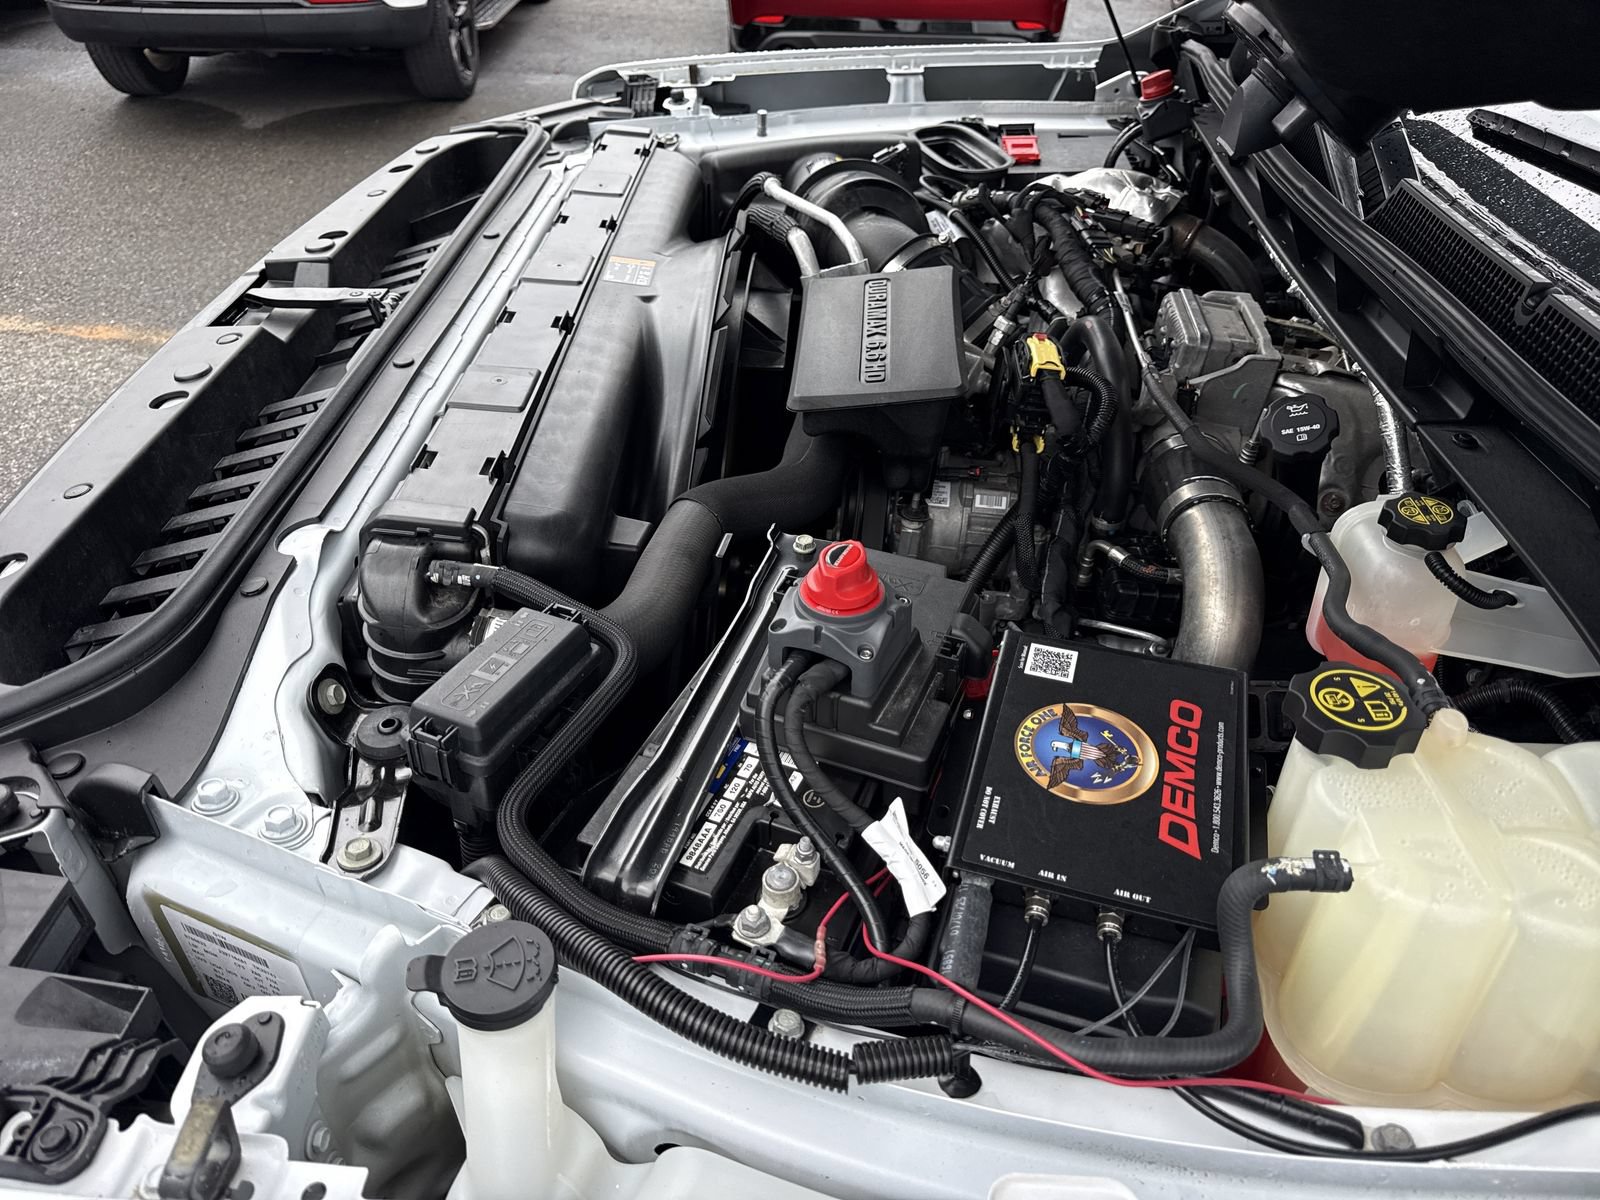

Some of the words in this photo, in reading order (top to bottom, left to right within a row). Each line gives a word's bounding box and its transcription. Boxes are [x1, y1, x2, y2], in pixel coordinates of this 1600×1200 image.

[866, 280, 887, 338] DURAMAX
[1296, 424, 1320, 432] 15W-40
[1030, 708, 1058, 724] ONE
[1019, 725, 1034, 757] FORCE
[744, 764, 752, 772] 70
[1026, 760, 1047, 776] AIR
[1158, 699, 1203, 860] DEMCO
[730, 783, 740, 794] 120
[985, 786, 992, 796] DO
[982, 796, 990, 808] NOT
[988, 796, 1000, 824] EXHAUST
[976, 808, 987, 829] COVER
[686, 828, 712, 861] 9848AAA
[1211, 833, 1220, 854] Demco
[980, 854, 1015, 869] VACUUM
[1038, 870, 1054, 880] AIR
[1056, 874, 1068, 882] IN
[1113, 888, 1130, 898] AIR
[1132, 893, 1152, 904] OUT
